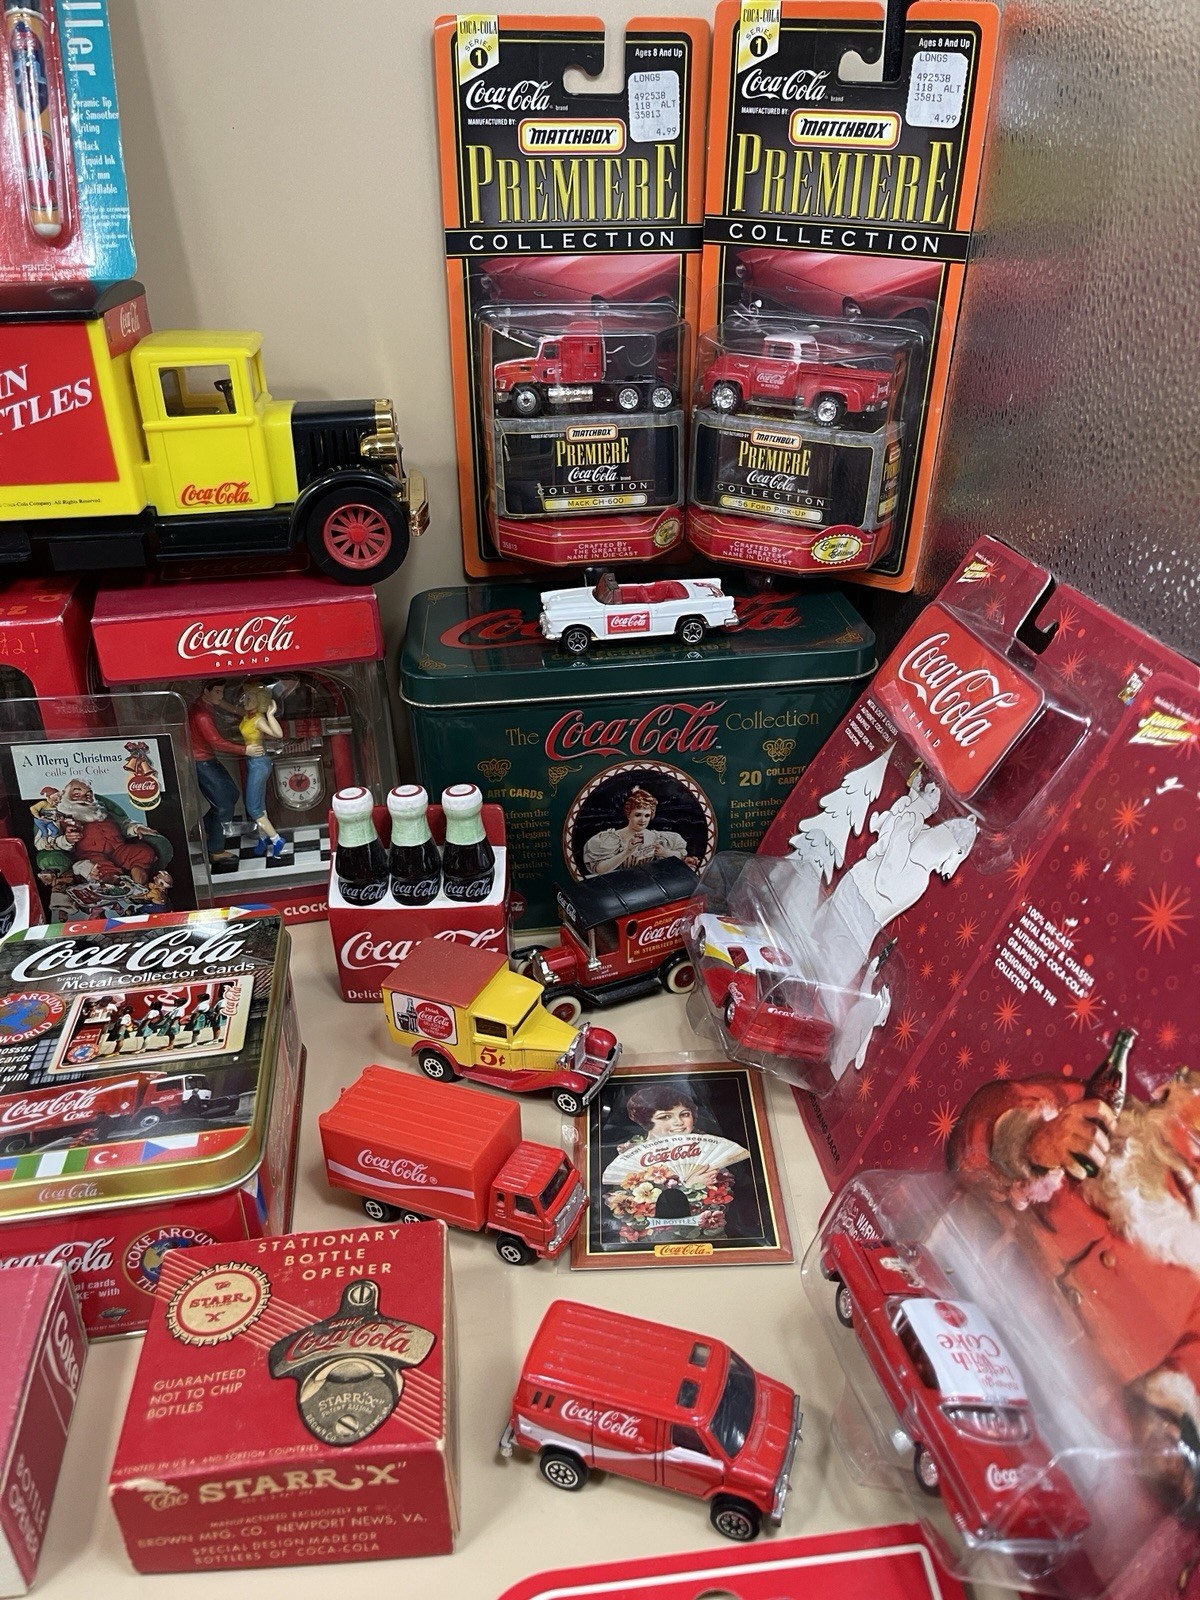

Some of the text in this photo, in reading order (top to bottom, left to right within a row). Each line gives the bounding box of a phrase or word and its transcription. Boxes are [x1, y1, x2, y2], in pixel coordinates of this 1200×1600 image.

[742, 8, 780, 23] COCA-COLA
[459, 20, 497, 35] COCA-COLA
[745, 26, 772, 41] SERIES
[62, 2, 104, 76] ller
[464, 39, 493, 52] SERIES
[755, 38, 763, 55] 1
[918, 37, 971, 49] Ages 8 And Up
[474, 49, 483, 66] 1
[635, 48, 683, 59] Ages 8 And Up
[919, 53, 948, 63] LONGS
[633, 73, 661, 83] LONGS
[741, 68, 832, 101] Coca-Cola
[917, 73, 951, 83] 492538
[465, 80, 553, 111] Coca-Cola
[634, 91, 666, 101] 492538
[916, 83, 962, 94] 118 ALT
[102, 96, 112, 109] Tip
[635, 100, 677, 110] 118 ALT
[914, 93, 943, 102] 35813
[86, 109, 119, 120] Smoother
[634, 110, 661, 119] 35813
[741, 107, 780, 115] MANUFACTURED
[934, 114, 957, 124] 4.99
[467, 118, 508, 126] MANUFACTURED
[800, 118, 892, 139] MATCHBOX
[529, 128, 616, 144] MATCHBOX
[656, 127, 677, 136] 4.99
[105, 154, 115, 165] Ink
[465, 144, 678, 224] PREMIERE
[731, 133, 954, 225] PREMIERE
[469, 231, 674, 250] COLLECTION
[729, 223, 939, 254] COLLECTION
[120, 302, 140, 337] Coca-Cola
[571, 428, 613, 438] MATCHBOX
[756, 432, 797, 445] MATCHBOX
[556, 437, 630, 467] PREMIERE
[738, 441, 812, 476] PREMIERE
[568, 465, 618, 483] Coca-Cola
[747, 470, 797, 491] Coca-Cola
[180, 481, 250, 506] Coca-Cola
[537, 482, 648, 495] COLLECTION
[717, 483, 825, 507] COLLECTION
[592, 497, 624, 505] CH-600
[578, 542, 615, 550] CRAFTED
[591, 546, 632, 554] GREATEST
[734, 541, 765, 551] CRAFTED
[747, 548, 787, 559] GREATEST
[610, 615, 647, 628] Coca-Cola
[177, 614, 297, 660] Coca-Cola
[215, 656, 270, 668] BRAND
[898, 632, 1020, 747] Coca-Cola
[506, 700, 820, 760] The Coca-Cola Collection
[902, 703, 941, 748] BRAND
[22, 752, 123, 767] A Merry Christmas
[45, 765, 110, 777] calls for Coke
[739, 770, 762, 787] 20
[128, 781, 156, 791] Coca-Cola
[488, 788, 544, 800] ART CARDS
[730, 798, 782, 808] Each embo
[510, 811, 532, 819] from
[731, 811, 739, 819] is
[730, 820, 756, 828] color
[341, 878, 491, 900] Coca-Cola Coca-Cola Coca-Cola
[283, 902, 328, 916] CLOCK
[1044, 921, 1074, 950] DIE-CAST
[11, 921, 259, 983] Coca-Cola
[1008, 937, 1039, 969] GRAPHICS
[1020, 916, 1094, 987] METAL BODY CHASSIS
[1013, 928, 1084, 998] AUTHENTIC COCA-COLA
[60, 961, 255, 990] Metal Collector Cards
[995, 958, 1028, 993] COLLECTOR
[1001, 948, 1057, 1006] DESIGNED FOR THE
[347, 990, 382, 999] Delici
[18, 993, 63, 1014] AROUND
[0, 1021, 53, 1044] WORLD
[3, 1072, 30, 1083] with
[2, 1086, 102, 1124] Coca-Cola
[642, 1139, 669, 1149] knows
[686, 1136, 719, 1145] season
[640, 1141, 702, 1167] Coca-Cola
[357, 1149, 429, 1185] Coca-Cola
[39, 1182, 98, 1201] Coca-Cola
[258, 1229, 401, 1253] STATIONARY
[127, 1234, 155, 1269] COKE
[284, 1249, 366, 1266] BOTTLE
[659, 1244, 706, 1256] Coca-Cola
[303, 1263, 392, 1281] OPENER
[88, 1279, 115, 1290] cards
[99, 1288, 120, 1297] with
[189, 1293, 252, 1309] STARR
[287, 1321, 411, 1362] Coca-Cola
[153, 1367, 247, 1392] GUARANTEED
[150, 1382, 244, 1406] NOT TO CHIP
[146, 1401, 204, 1421] BOTTLES
[560, 1399, 641, 1441] Coca-Cola
[199, 1467, 364, 1506] STARR
[292, 1505, 368, 1519] EXCLUSIVELY BY
[137, 1533, 194, 1550] BROWN
[276, 1517, 345, 1534] NEWPORT
[192, 1531, 377, 1556] SPECIAL DESIGN MADE FOR
[194, 1542, 381, 1566] BOTTLERS OF COCA-COLA
